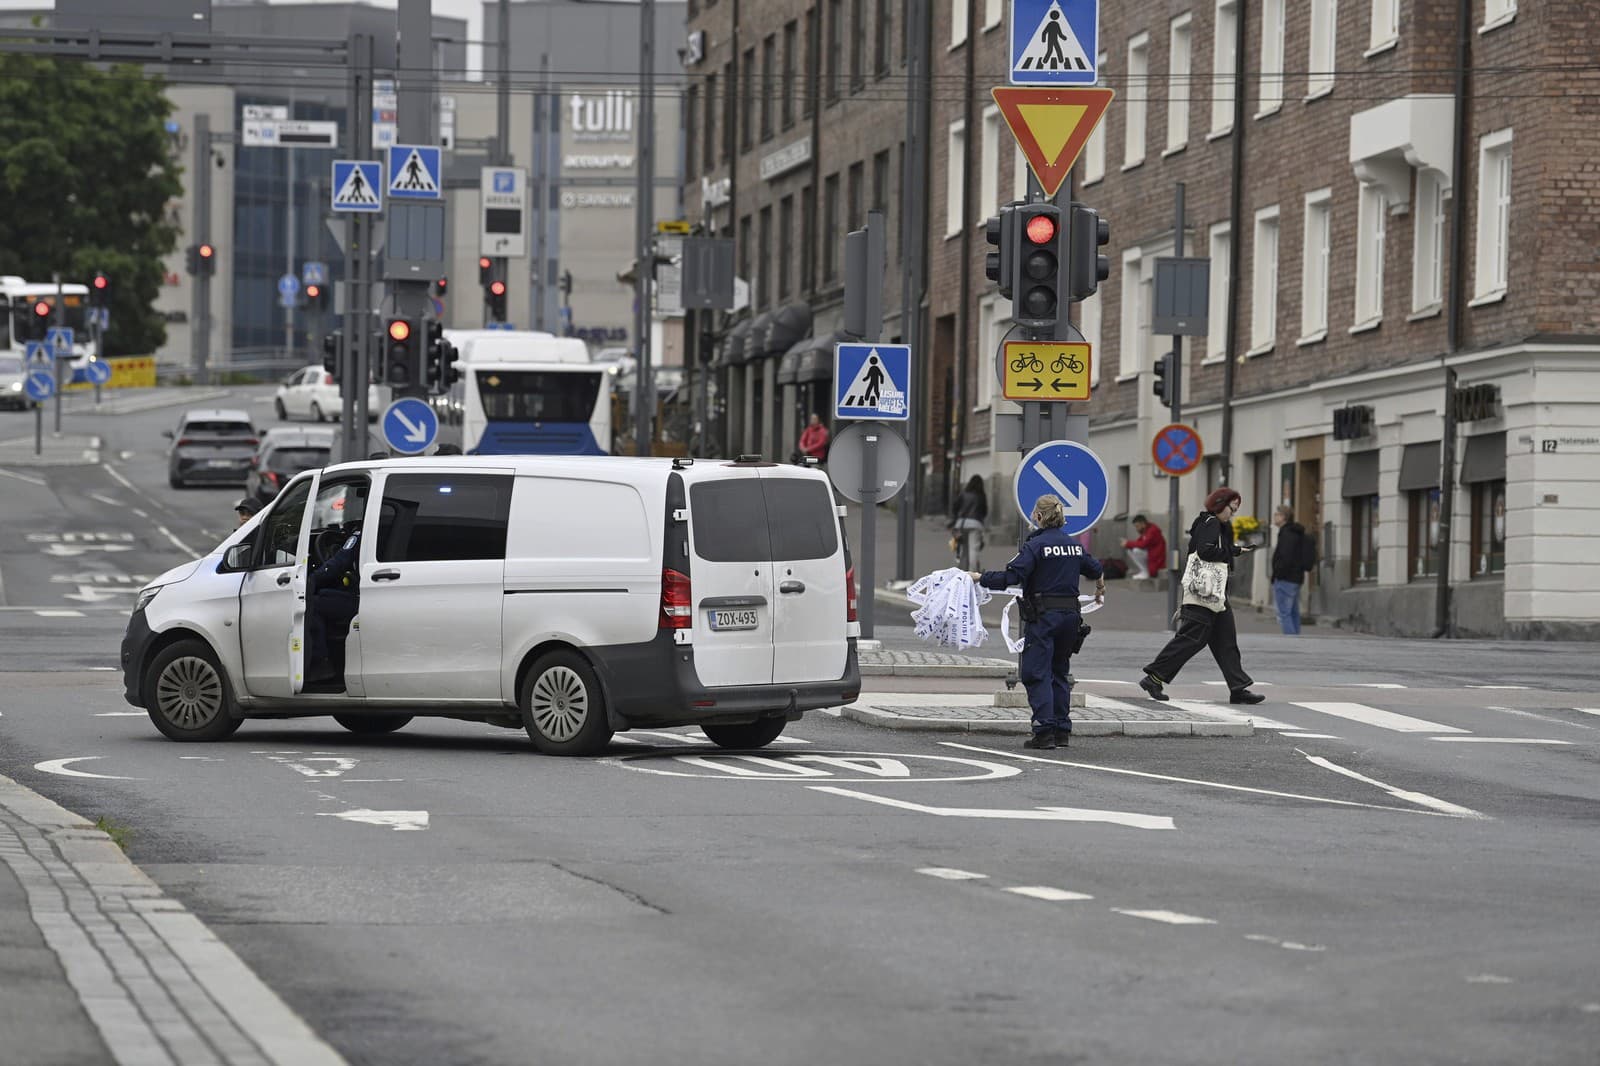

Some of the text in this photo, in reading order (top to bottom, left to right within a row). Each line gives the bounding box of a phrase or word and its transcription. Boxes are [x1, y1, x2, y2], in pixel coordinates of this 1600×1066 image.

[570, 90, 633, 132] tulli
[1544, 440, 1556, 453] 12
[717, 611, 757, 626] ZOX-493
[672, 754, 911, 777] 40
